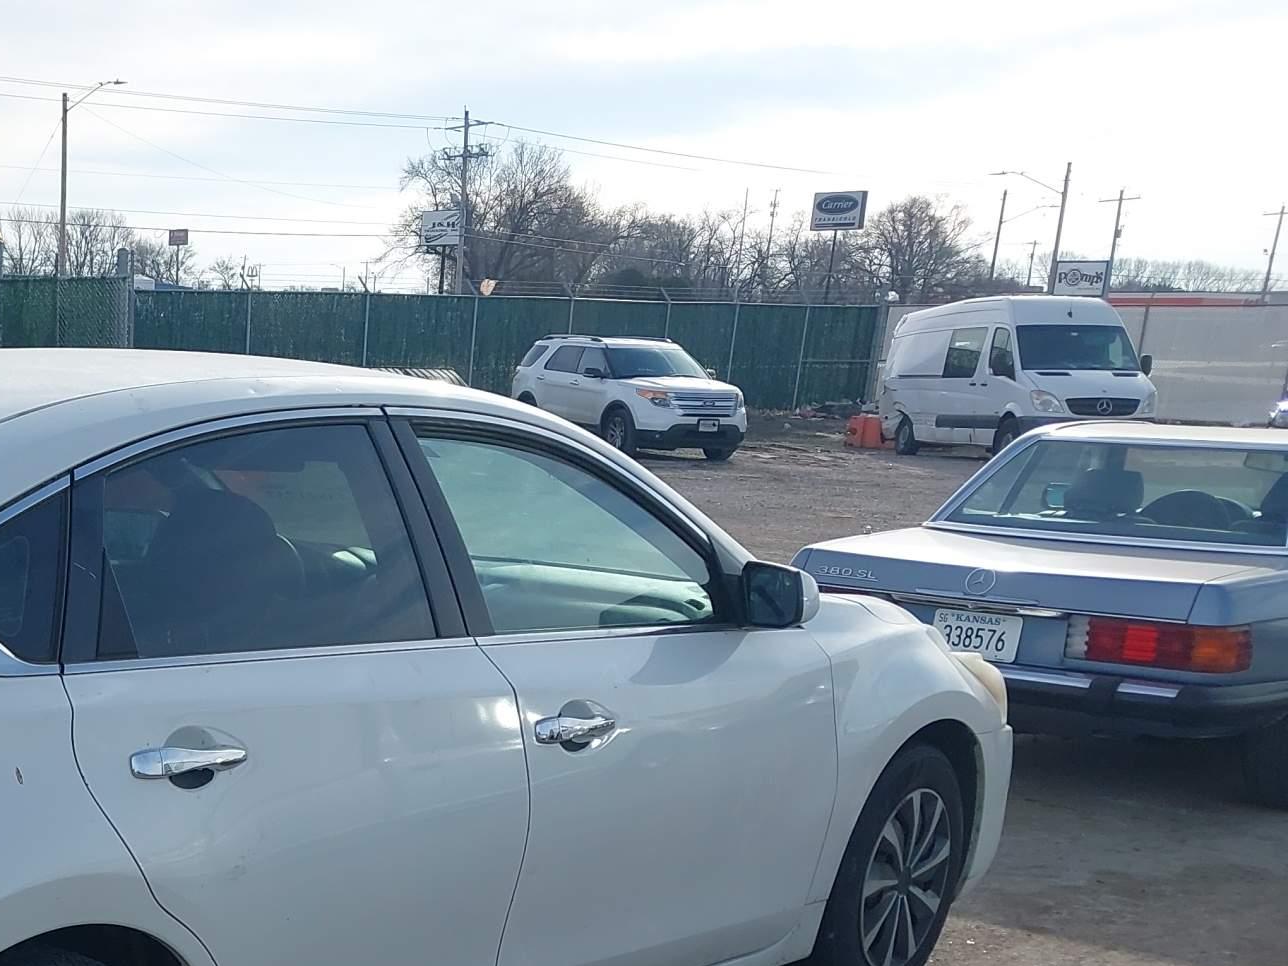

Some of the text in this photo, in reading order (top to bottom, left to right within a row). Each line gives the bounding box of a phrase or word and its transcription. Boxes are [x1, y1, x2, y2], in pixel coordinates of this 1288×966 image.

[822, 200, 854, 209] Carrier
[818, 565, 877, 580] 380 SL
[955, 613, 1002, 626] KANSAS
[943, 624, 1006, 652] 338576
